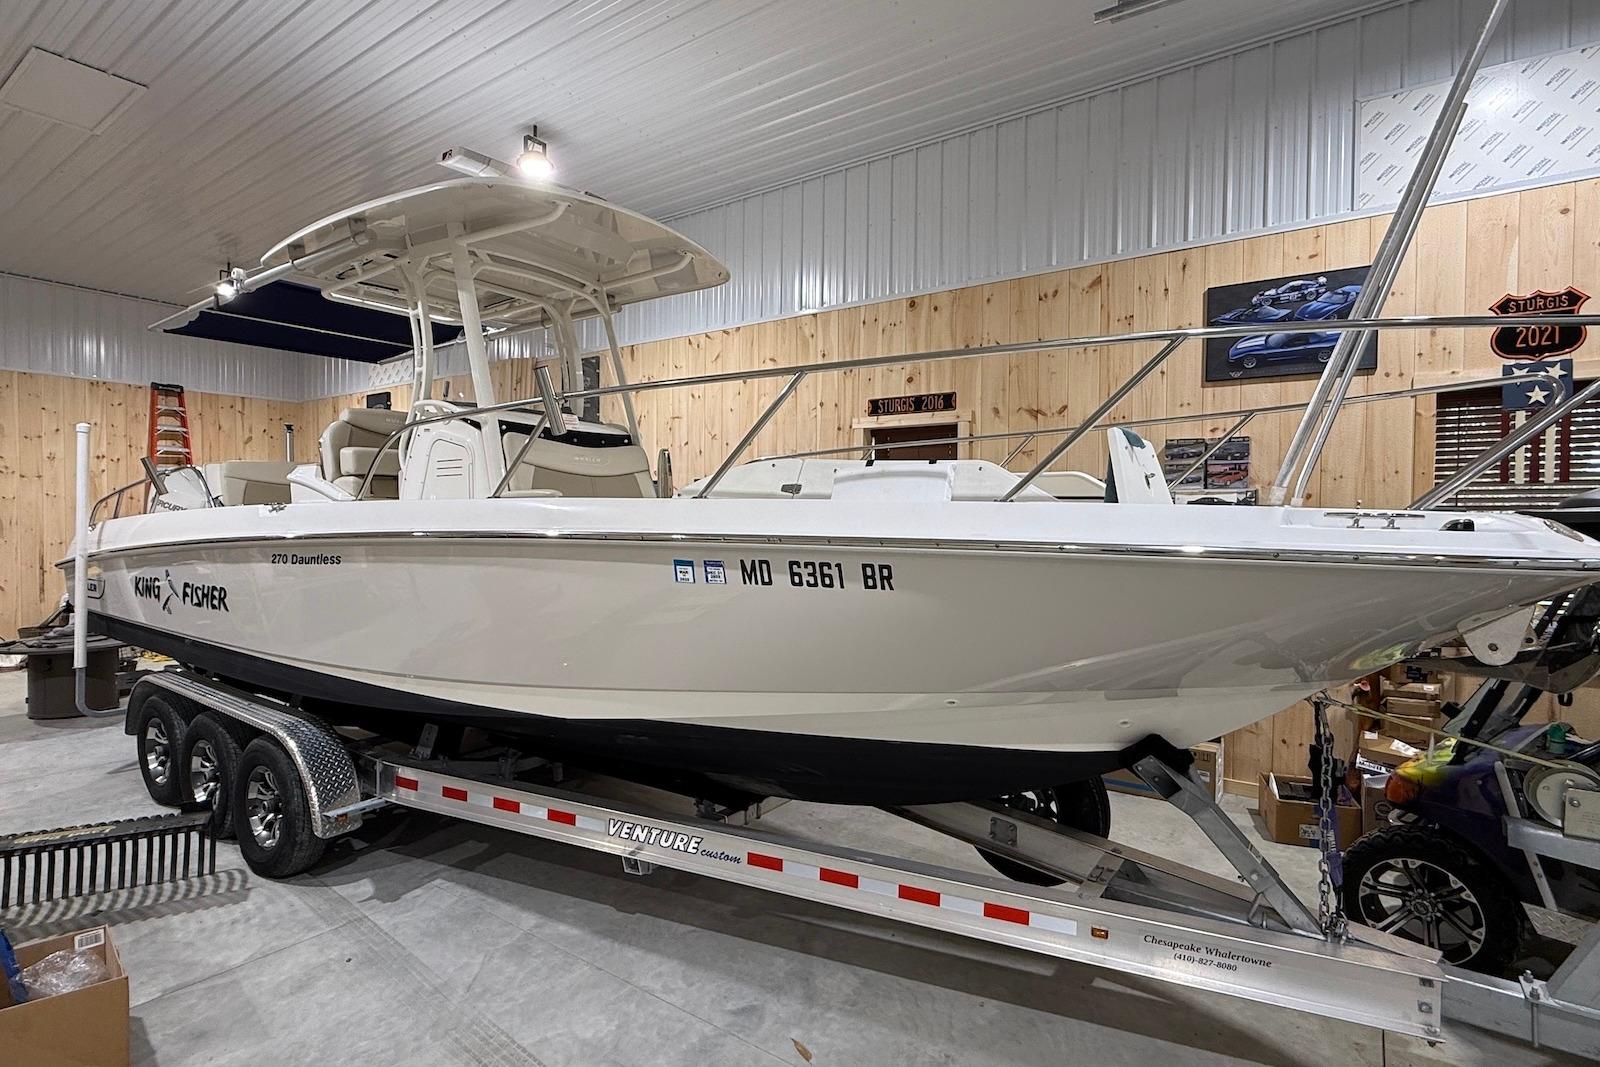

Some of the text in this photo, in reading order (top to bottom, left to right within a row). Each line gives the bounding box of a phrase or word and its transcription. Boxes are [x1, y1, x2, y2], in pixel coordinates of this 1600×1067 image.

[1508, 295, 1569, 313] STURGIS
[1515, 325, 1560, 348] 2021
[878, 395, 944, 414] STURGIS 2016
[271, 553, 342, 565] 270 Dauntless
[740, 559, 895, 591] MD 6361 BR
[134, 576, 230, 613] KING FISHER
[607, 818, 743, 864] VENTURE custom
[1143, 934, 1273, 968] Chesapeake Whalertowne
[1173, 952, 1238, 972] (410)-827-8080
